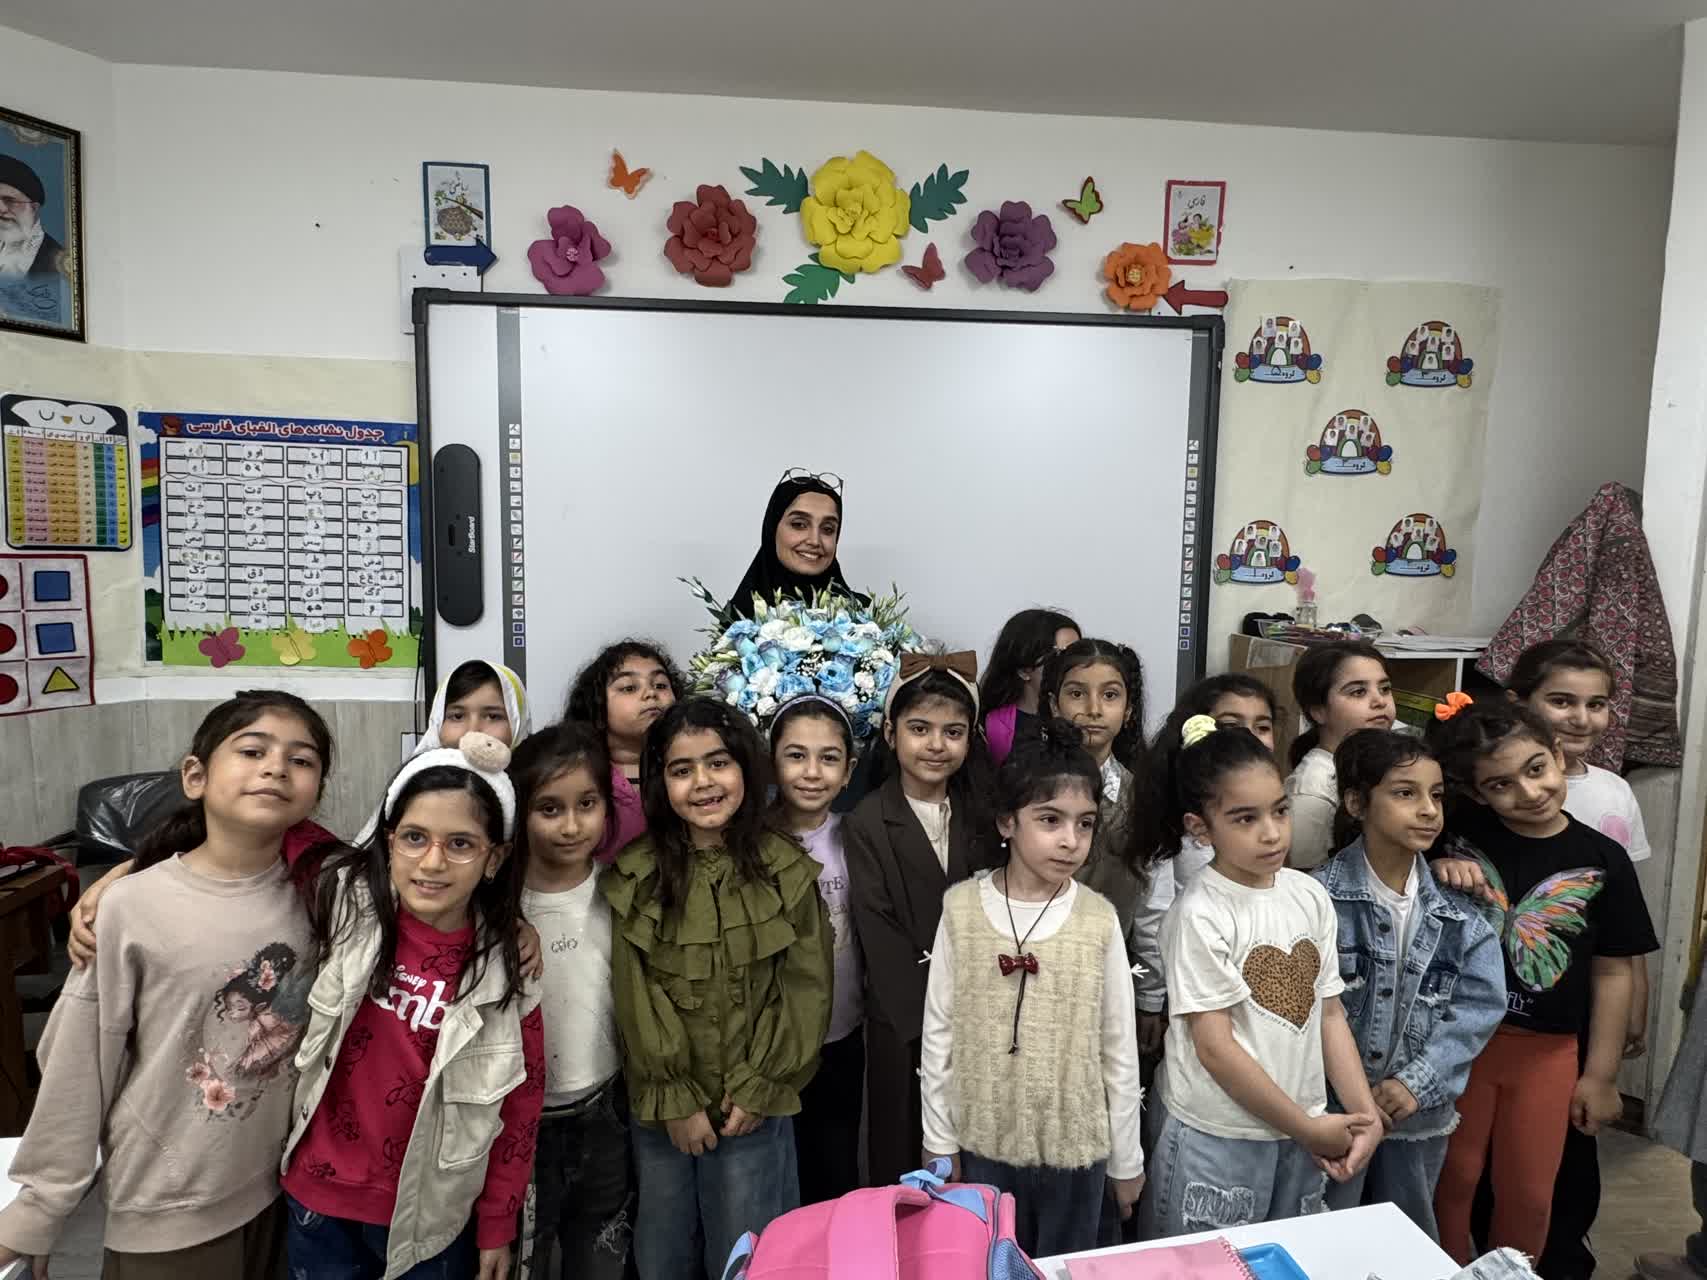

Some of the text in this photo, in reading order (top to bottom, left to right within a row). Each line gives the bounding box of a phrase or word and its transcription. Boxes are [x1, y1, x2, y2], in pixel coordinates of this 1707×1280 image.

[186, 419, 384, 440] جدول نشانه های الفبای فارسی
[467, 515, 476, 554] StarBoard
